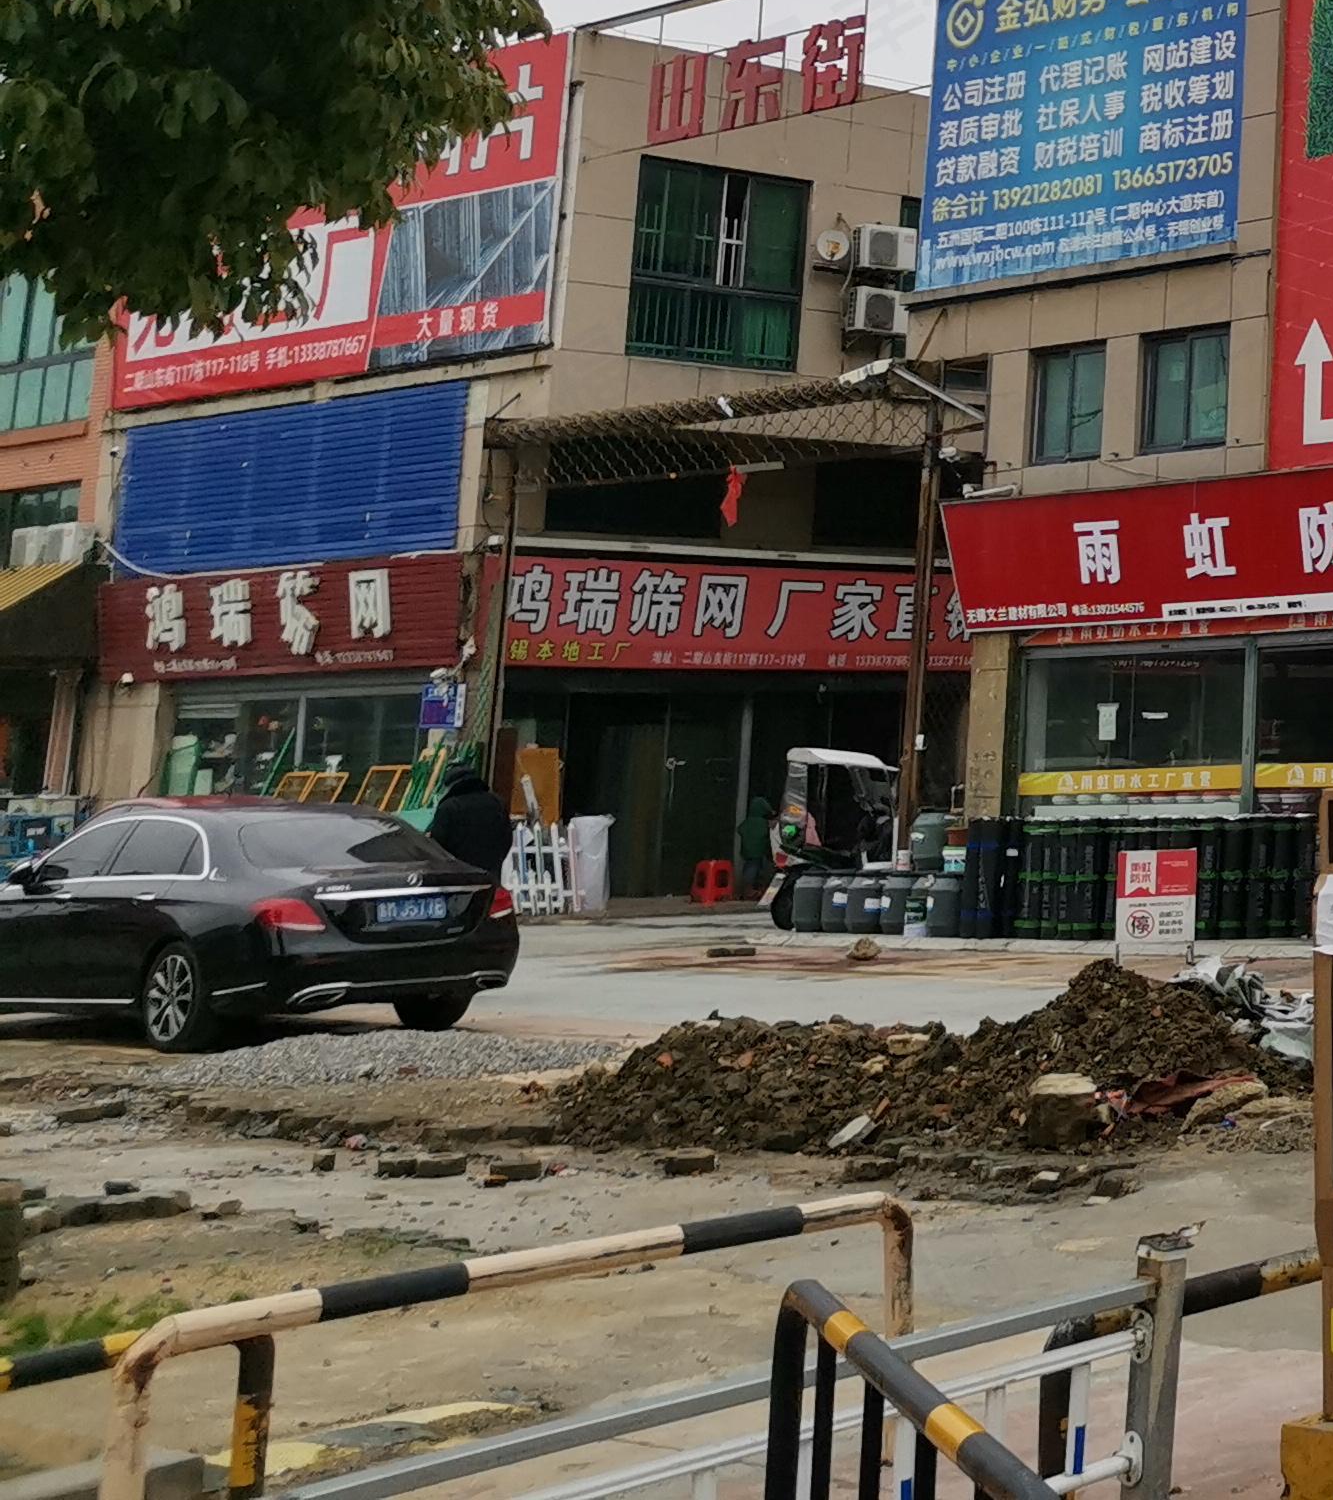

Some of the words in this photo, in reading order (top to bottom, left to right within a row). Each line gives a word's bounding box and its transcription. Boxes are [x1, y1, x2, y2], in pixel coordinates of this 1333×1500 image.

[648, 16, 867, 144] 山东街
[938, 109, 1023, 151] 资质审批
[1036, 90, 1126, 133] 社保人事
[1140, 70, 1234, 114] 税收筹划
[942, 70, 1027, 112] 公司注册
[1039, 51, 1128, 94] 代理记账
[1143, 30, 1237, 75] 网站建设
[932, 191, 987, 222] 徐会计
[992, 173, 1103, 211] 13921282081
[1112, 152, 1234, 192] 13665173705
[935, 147, 1020, 187] 贷款融资
[1034, 128, 1123, 171] 财税培训
[1138, 109, 1234, 154] 商标注册
[416, 302, 499, 338] 大量现货
